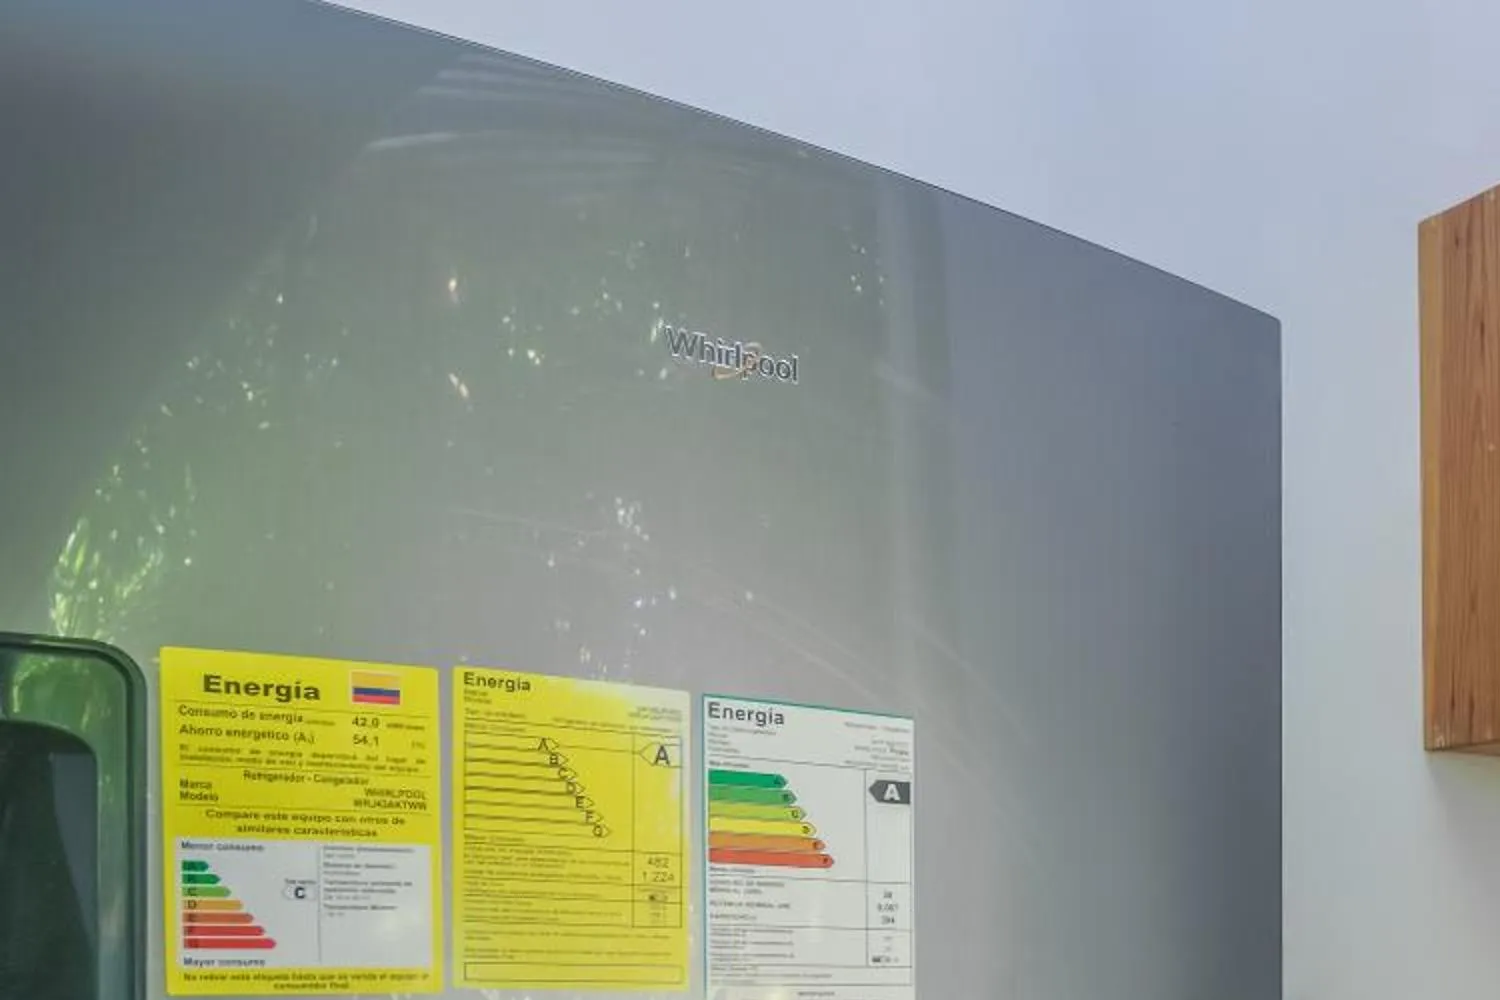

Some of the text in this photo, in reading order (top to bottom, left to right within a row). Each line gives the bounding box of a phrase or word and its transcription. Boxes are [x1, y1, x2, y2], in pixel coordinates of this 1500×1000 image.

[665, 326, 799, 384] Whirlpool
[179, 704, 238, 719] Consumo
[241, 709, 256, 720] de
[179, 724, 223, 737] Ahorro
[537, 737, 548, 751] A
[549, 753, 559, 766] B
[655, 745, 671, 766] A
[558, 767, 568, 780] C
[566, 781, 576, 795] D
[884, 783, 900, 801] A
[576, 795, 586, 809] E
[585, 809, 595, 823] F
[294, 885, 306, 899] C
